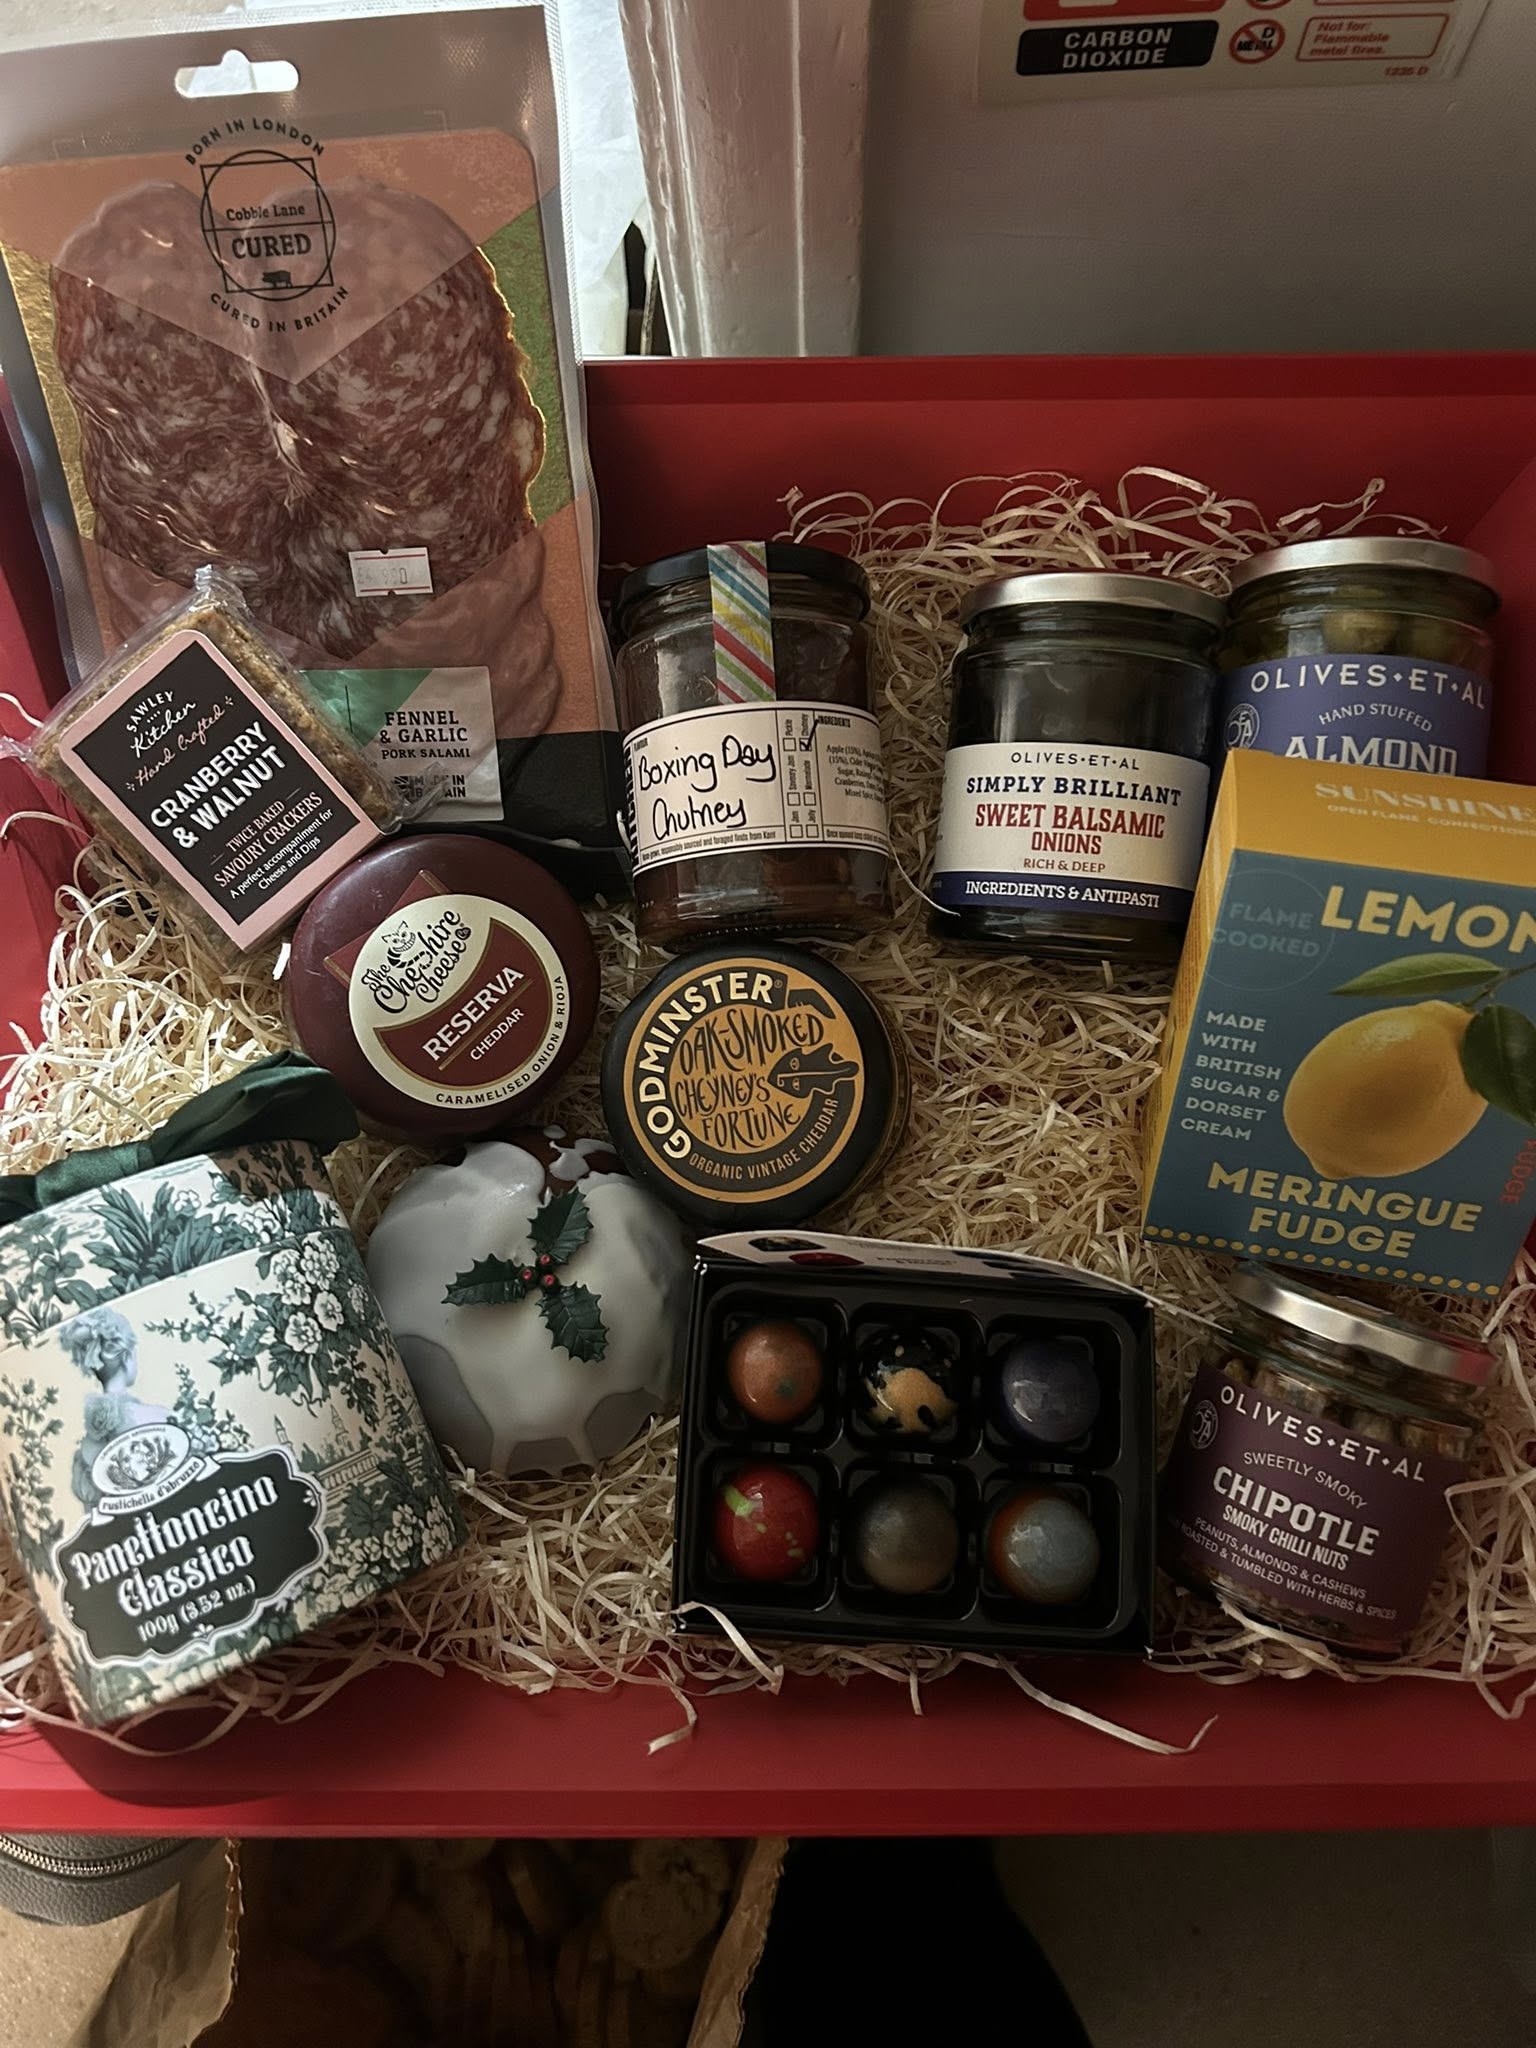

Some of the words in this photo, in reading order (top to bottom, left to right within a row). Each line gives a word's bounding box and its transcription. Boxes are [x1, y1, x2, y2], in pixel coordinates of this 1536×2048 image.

[1064, 27, 1173, 49] CARBON
[1318, 22, 1344, 31] Not
[1062, 47, 1166, 70] DIOXIDE
[1311, 46, 1347, 55] metal
[186, 127, 222, 165] BORN
[226, 118, 245, 134] IN
[253, 117, 325, 156] LONDON
[226, 205, 269, 221] Cobble
[273, 204, 305, 217] Lane
[232, 233, 312, 259] CURED
[210, 293, 260, 329] CURED
[269, 321, 286, 332] IN
[295, 286, 349, 330] BRITAIN
[126, 690, 175, 733] SAWLEY
[131, 701, 197, 758] Kitchen
[385, 711, 459, 726] FENNEL
[1318, 703, 1366, 726] HAND
[1369, 703, 1433, 733] STUFFED
[136, 749, 176, 787] Hand
[177, 705, 225, 751] Crafted
[380, 730, 392, 743] &
[398, 728, 468, 742] GARLIC
[382, 749, 416, 759] PORK
[420, 748, 471, 758] SALAMI
[1284, 735, 1458, 777] ALMOND
[150, 721, 268, 827] CRANBERRY
[452, 775, 465, 785] IN
[639, 746, 717, 792] Boxing
[722, 735, 776, 782] Day
[172, 826, 199, 849] &
[190, 745, 286, 831] WALNUT
[967, 776, 1046, 793] SIMPLY
[1053, 777, 1181, 806] BRILLIANT
[1315, 783, 1536, 824] SUNSHINE
[1328, 805, 1368, 815] OPEN
[1371, 810, 1419, 822] FLAME
[213, 839, 268, 887] SAVOURY
[266, 791, 323, 845] CRACKERS
[225, 827, 258, 853] TWICE
[254, 800, 286, 832] BAKED
[653, 795, 747, 840] Chutney
[975, 803, 1046, 827] SWEET
[1052, 804, 1165, 839] BALSAMIC
[229, 888, 240, 899] A
[238, 865, 266, 896] perfect
[317, 808, 334, 827] for
[258, 867, 288, 890] Cheese
[286, 852, 303, 870] and
[301, 836, 322, 860] Dips
[1031, 831, 1102, 854] ONIONS
[1024, 858, 1055, 870] RICH
[1057, 860, 1068, 871] &
[1072, 861, 1106, 873] DEEP
[965, 880, 1065, 899] INGREDIENTS
[1068, 884, 1079, 899] &
[1081, 888, 1160, 909] ANTIPASTI
[1228, 902, 1313, 932] FLAME
[1319, 883, 1536, 954] LEMON
[1210, 926, 1321, 958] COOKED
[361, 963, 391, 992] The
[415, 940, 467, 1004] Cheese
[422, 966, 525, 1062] RESERVA
[469, 1007, 525, 1062] CHEDDAR
[1205, 1009, 1268, 1032] MADE
[436, 1072, 531, 1105] CARAMELISED
[533, 1033, 560, 1073] ONION
[554, 976, 565, 1015] RIOJA
[679, 1007, 825, 1076] OAK-SMOKED
[1200, 1031, 1259, 1054] WITH
[638, 971, 773, 1160] GODMINSTER
[1195, 1054, 1283, 1082] BRITISH
[673, 1073, 771, 1121] CHEYNEY'S
[1185, 1096, 1267, 1122] DORSET
[1190, 1075, 1262, 1102] SUGAR
[1264, 1085, 1281, 1104] &
[689, 1152, 743, 1180] ORGANIC
[747, 1152, 801, 1179] VINTAGE
[798, 1097, 840, 1154] CHEDDAR
[702, 1101, 801, 1150] FORTUNE
[1180, 1116, 1253, 1142] CREAM
[1206, 1159, 1484, 1234] MERINGUE
[1248, 1205, 1417, 1260] FUDGE
[1243, 1451, 1314, 1477] SWEETLY
[1314, 1469, 1368, 1510] SMOKY
[70, 1475, 279, 1591] Panettoncino
[1213, 1465, 1380, 1557] CHIPOTLE
[1194, 1517, 1239, 1551] PEANUTS,
[1240, 1542, 1298, 1576] ALMONDS
[1299, 1568, 1310, 1580] &
[1311, 1572, 1367, 1599] CASHEWS
[1222, 1503, 1270, 1539] SMOKY
[1268, 1525, 1310, 1557] CHILLI
[1312, 1542, 1349, 1571] NUTS
[118, 1535, 256, 1617] Classico
[1219, 1548, 1229, 1560] &
[1229, 1551, 1284, 1586] TUMBLED
[1286, 1578, 1316, 1599] WITH
[1317, 1590, 1355, 1611] HERBS
[1355, 1603, 1364, 1614] &
[137, 1613, 179, 1643] 100g
